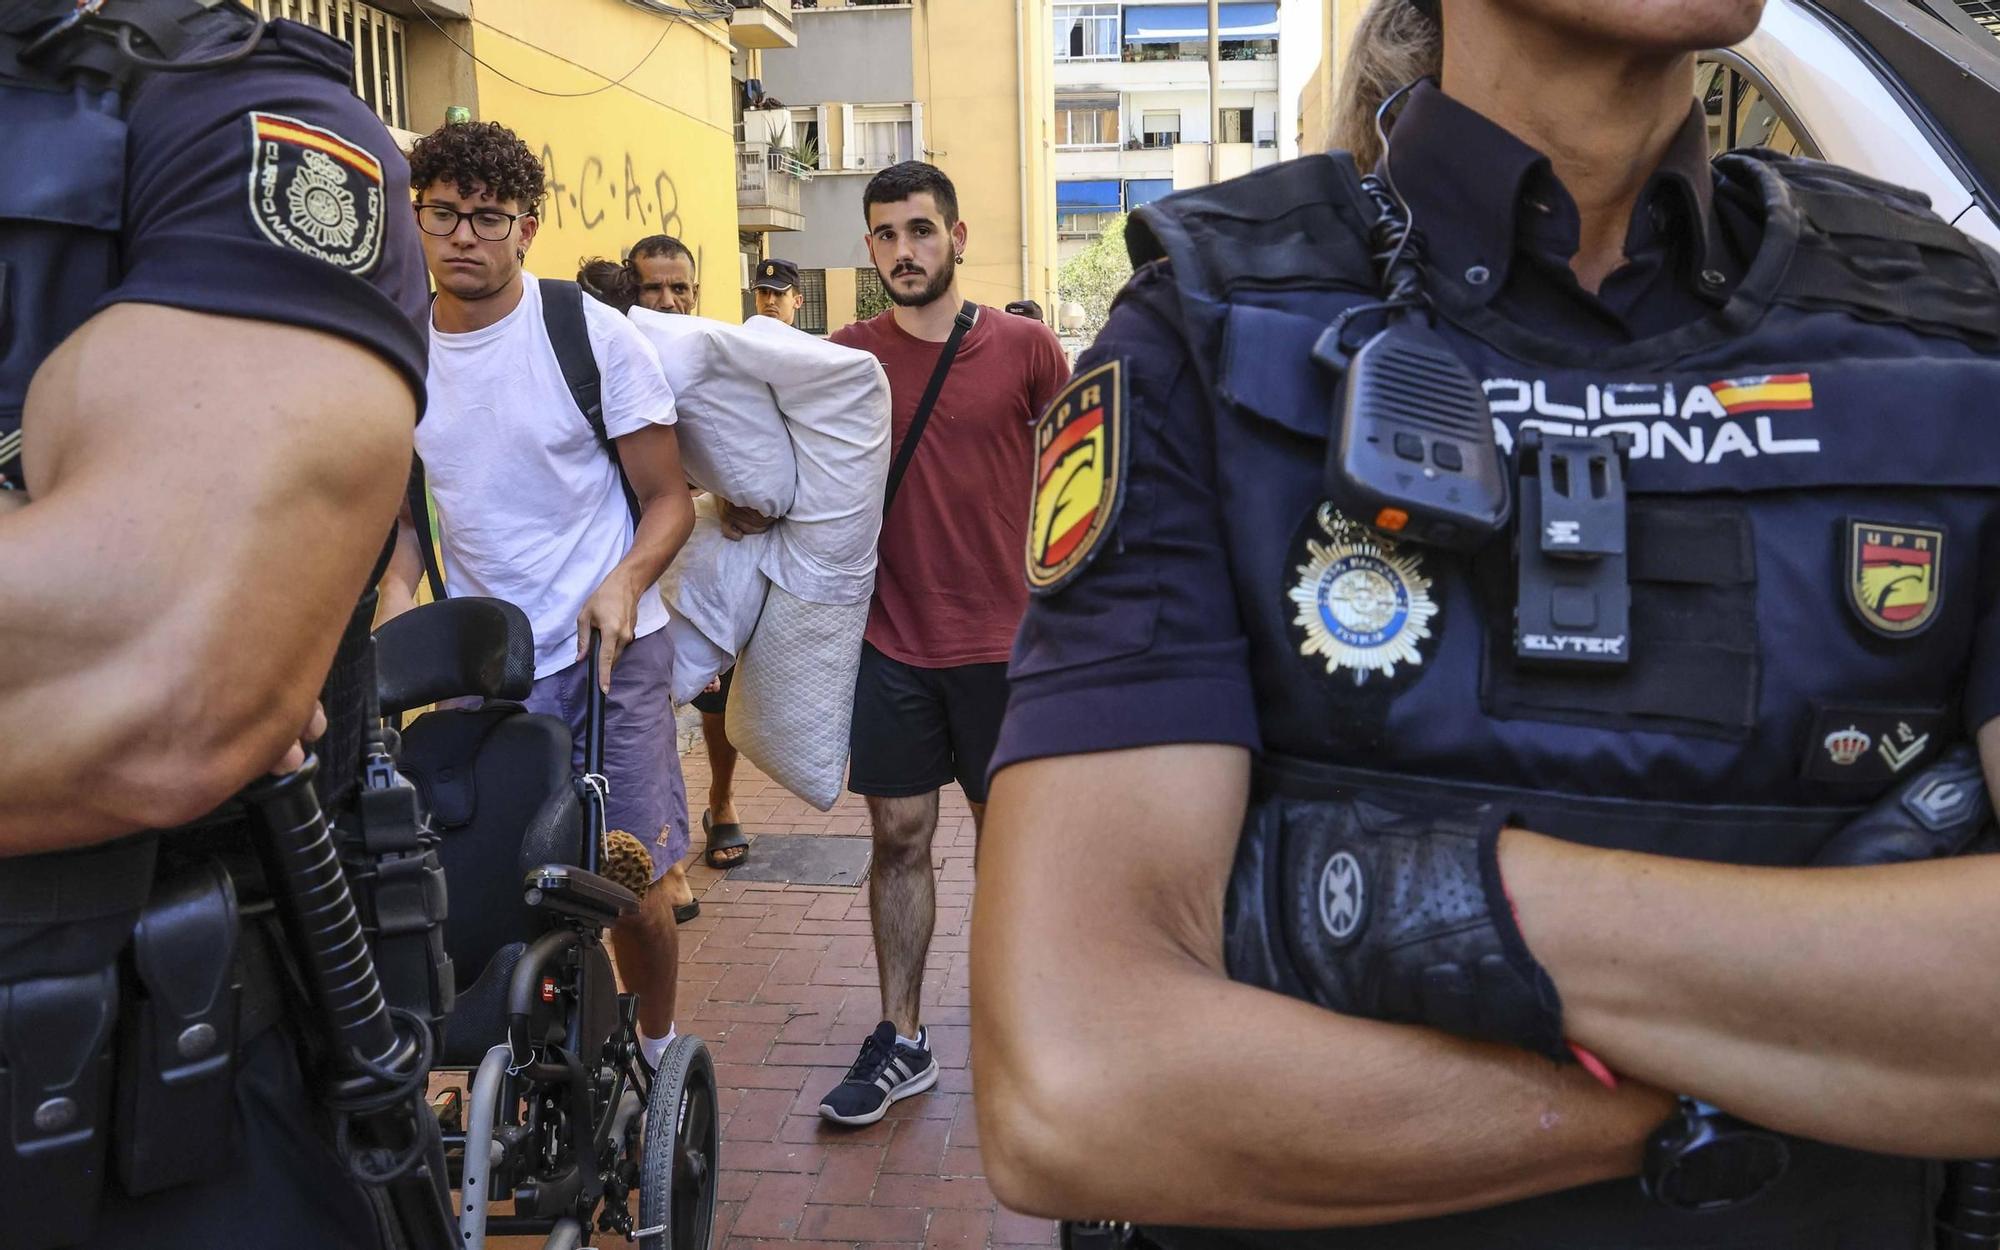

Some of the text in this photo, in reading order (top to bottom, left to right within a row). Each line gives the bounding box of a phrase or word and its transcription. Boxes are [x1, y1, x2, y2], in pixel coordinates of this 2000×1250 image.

[262, 142, 278, 213] CUERPO
[267, 216, 353, 266] NACIONAL
[1481, 377, 1727, 421] OLICIA
[1522, 634, 1625, 654] ELYTER
